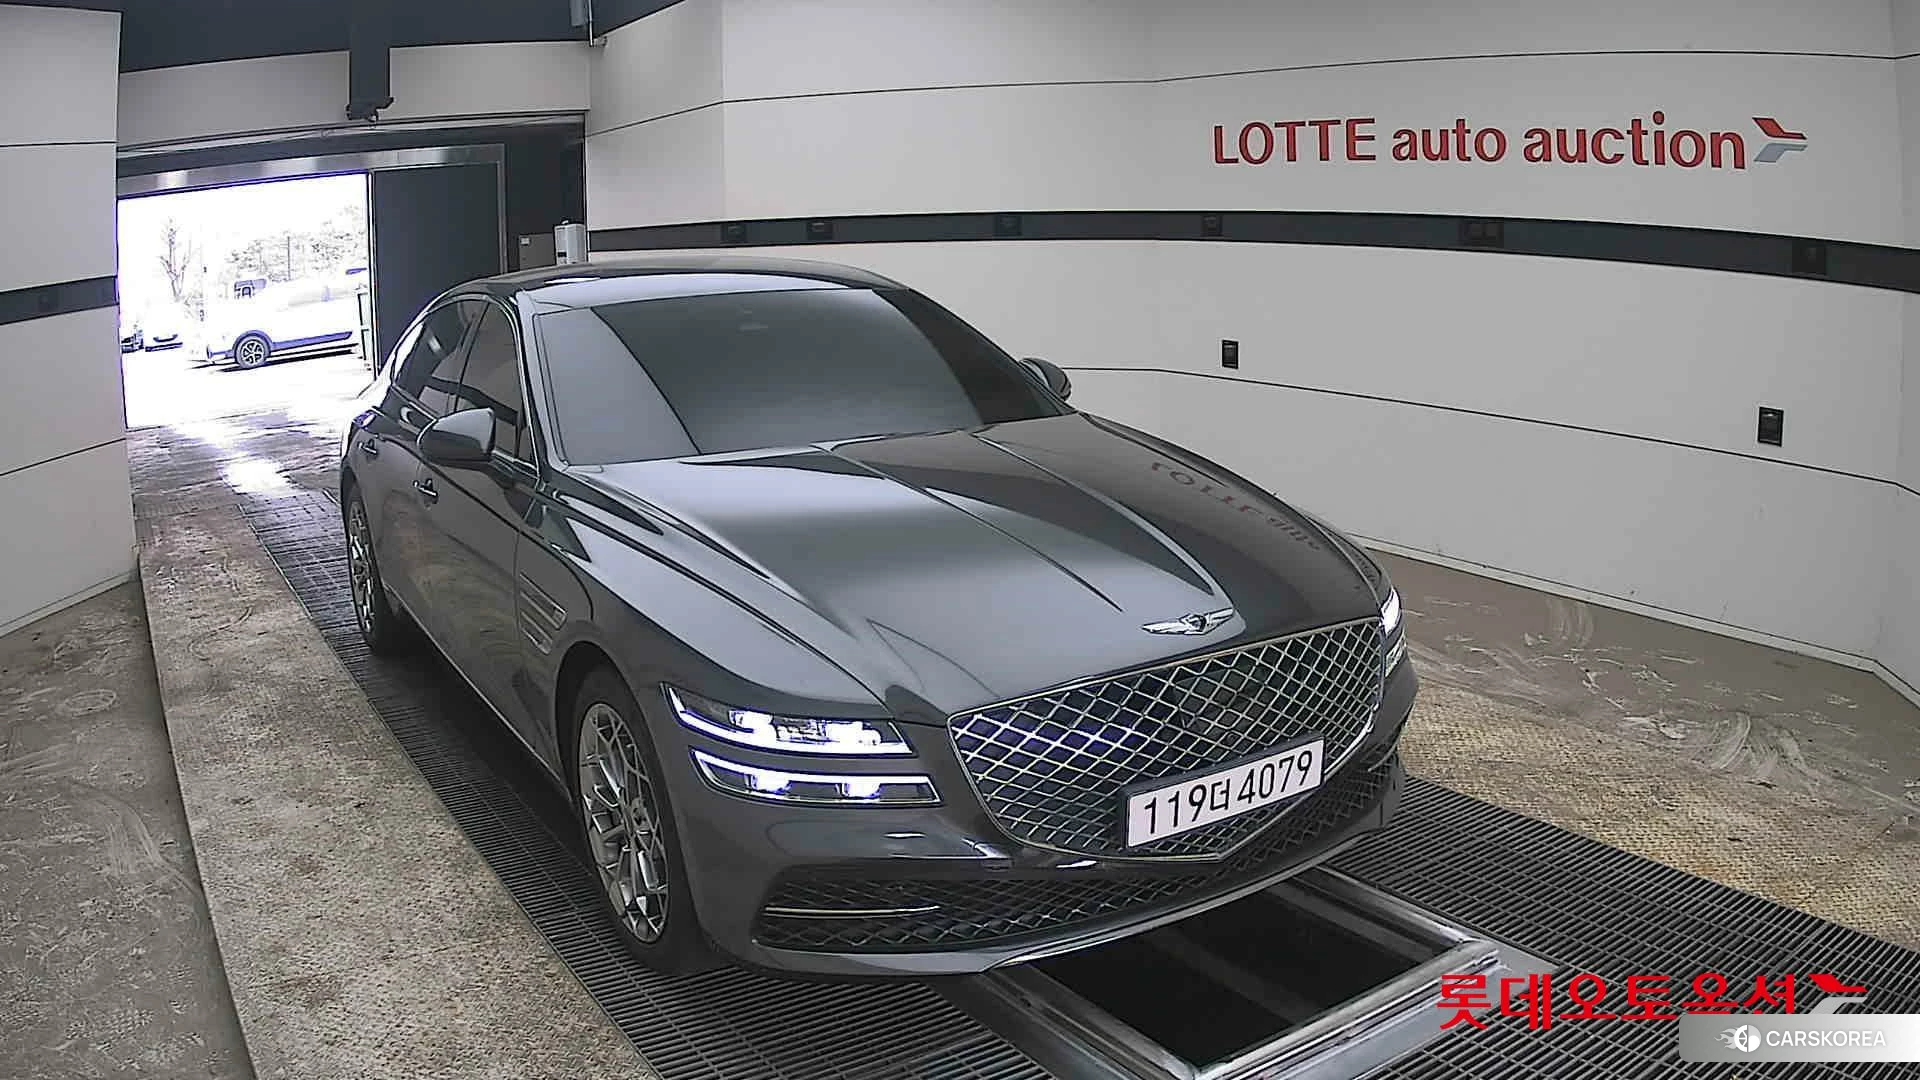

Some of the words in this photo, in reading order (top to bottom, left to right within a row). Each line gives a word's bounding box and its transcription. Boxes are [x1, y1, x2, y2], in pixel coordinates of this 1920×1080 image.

[1213, 117, 1377, 165] LOTTE
[1393, 117, 1508, 163] auto
[1523, 111, 1746, 170] auction
